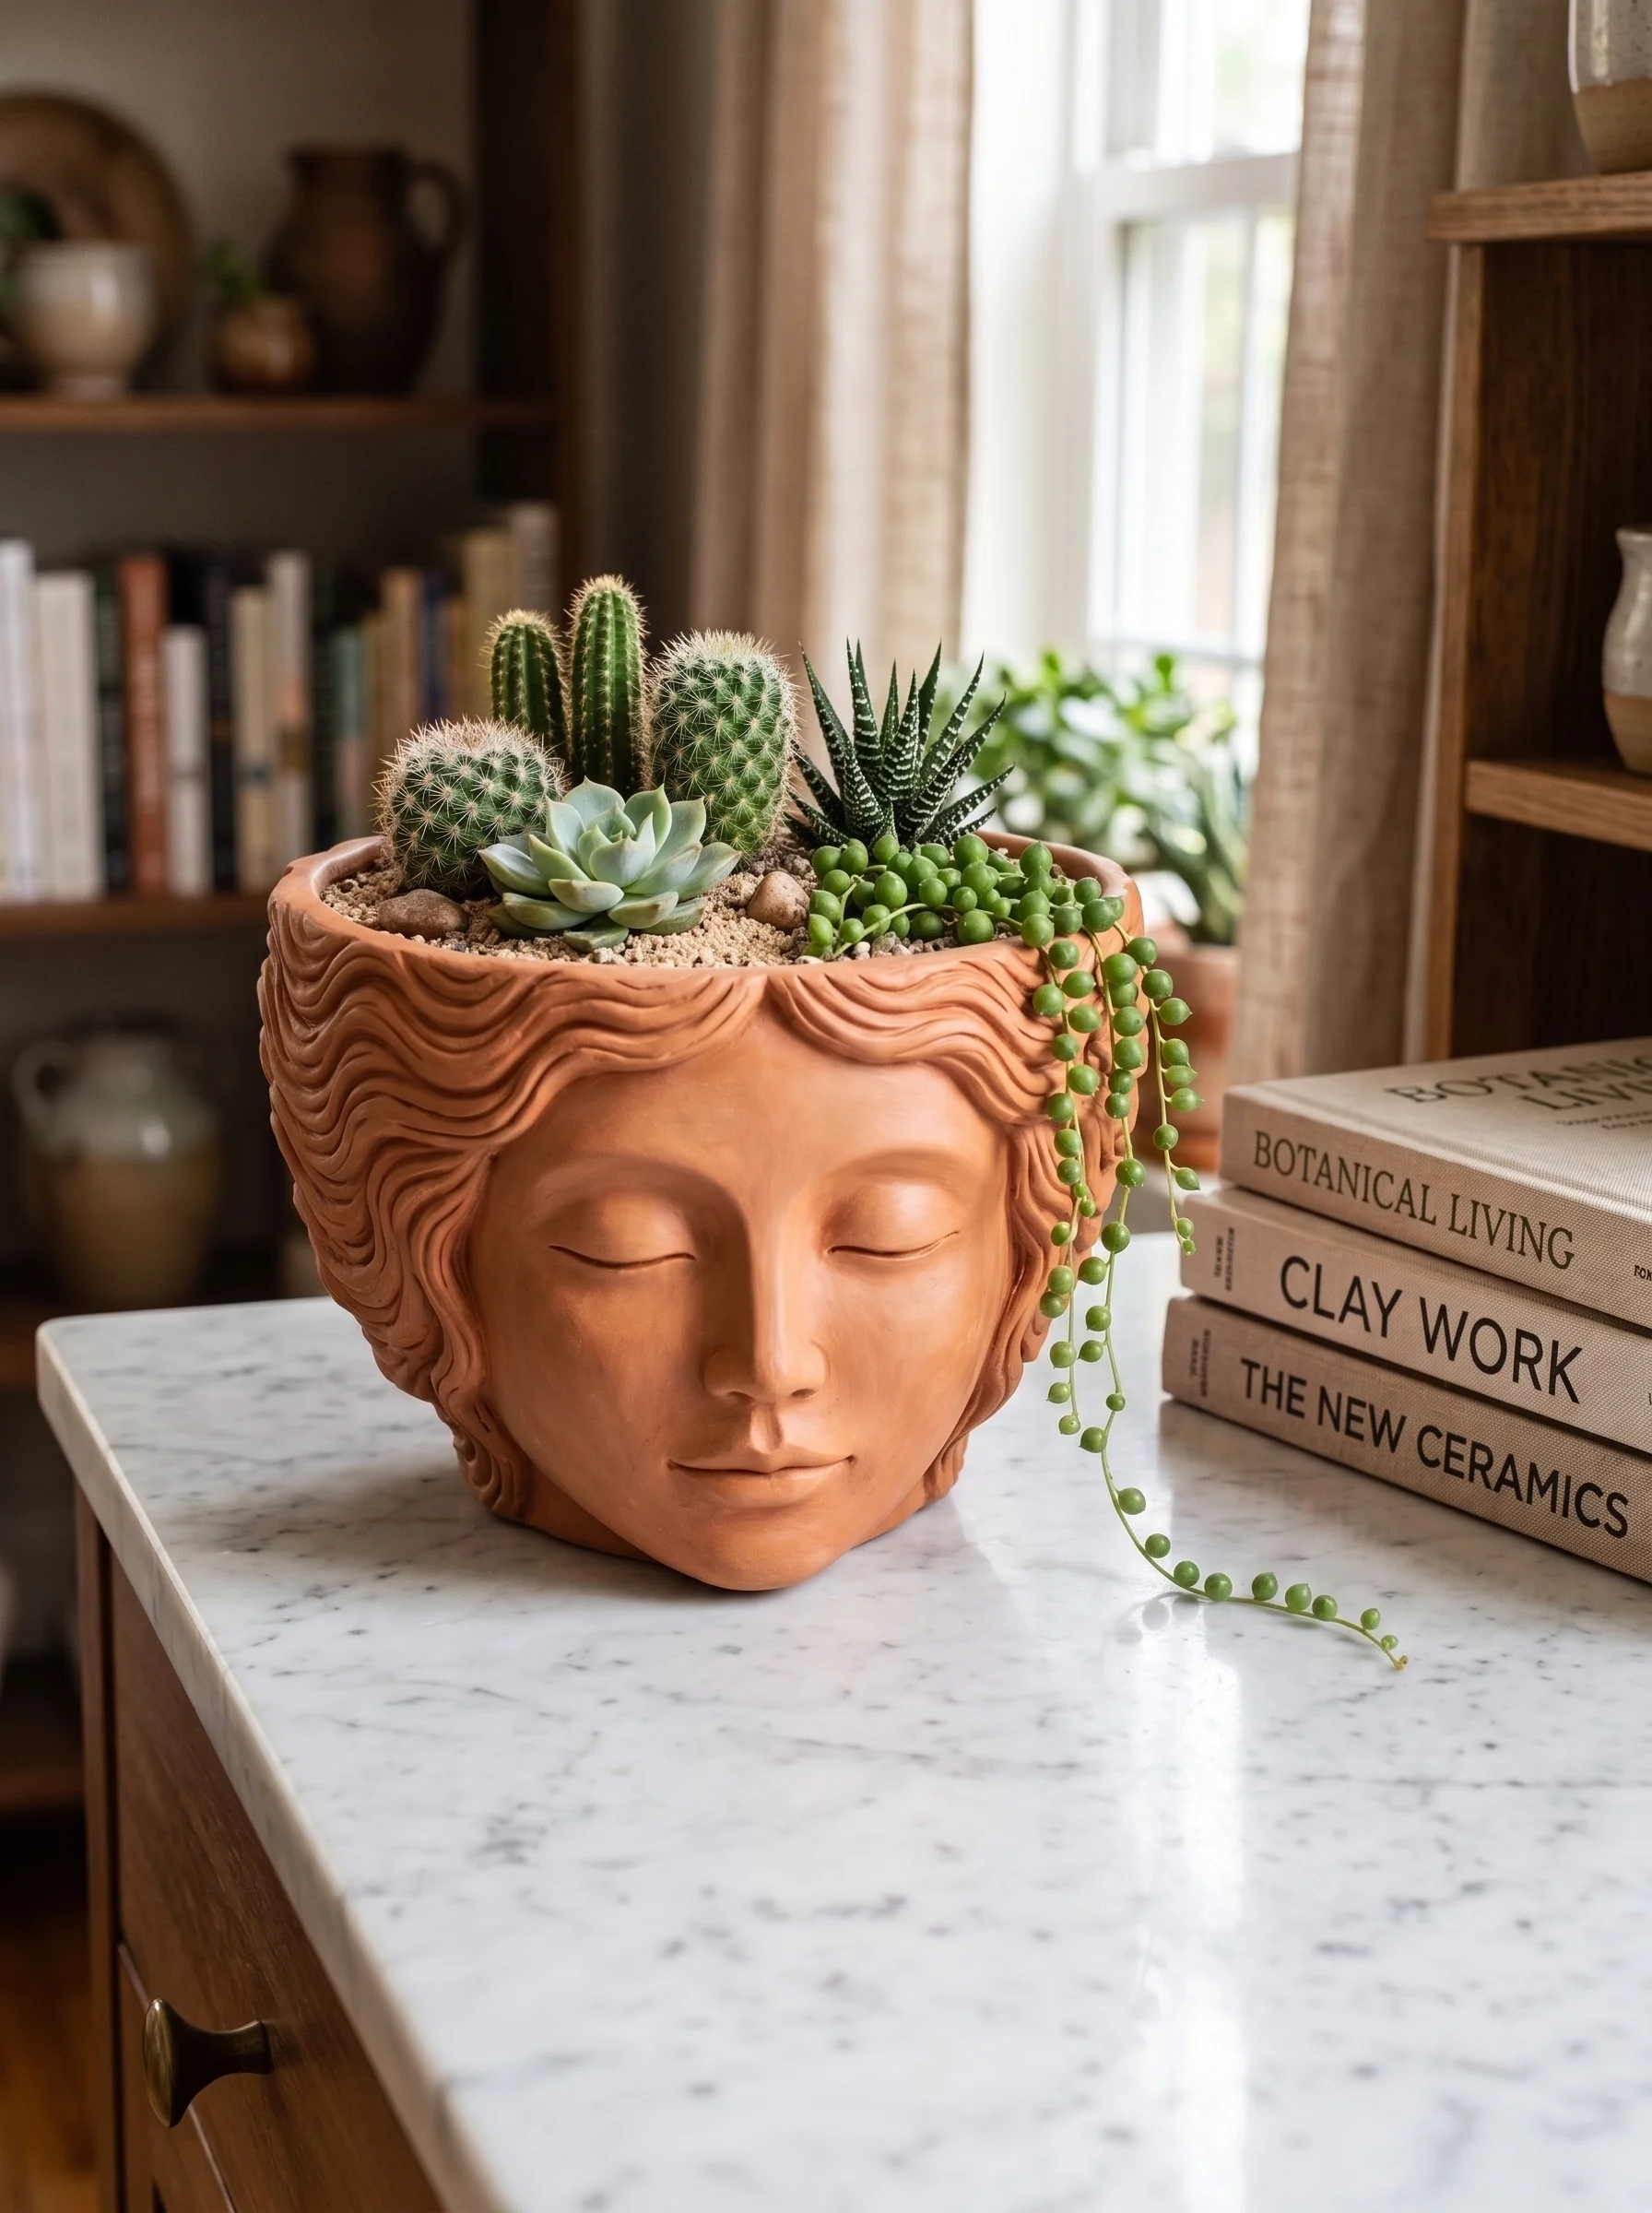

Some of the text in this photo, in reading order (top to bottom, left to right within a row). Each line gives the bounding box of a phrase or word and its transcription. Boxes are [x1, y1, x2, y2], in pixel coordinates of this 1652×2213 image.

[1254, 1130, 1575, 1270] BOTANICAL LIVING
[1280, 1255, 1403, 1338] CLAY
[1419, 1296, 1583, 1404] WORK
[1241, 1358, 1307, 1419] THE
[1317, 1386, 1407, 1454] NEW
[1416, 1425, 1629, 1539] CERAMICS
